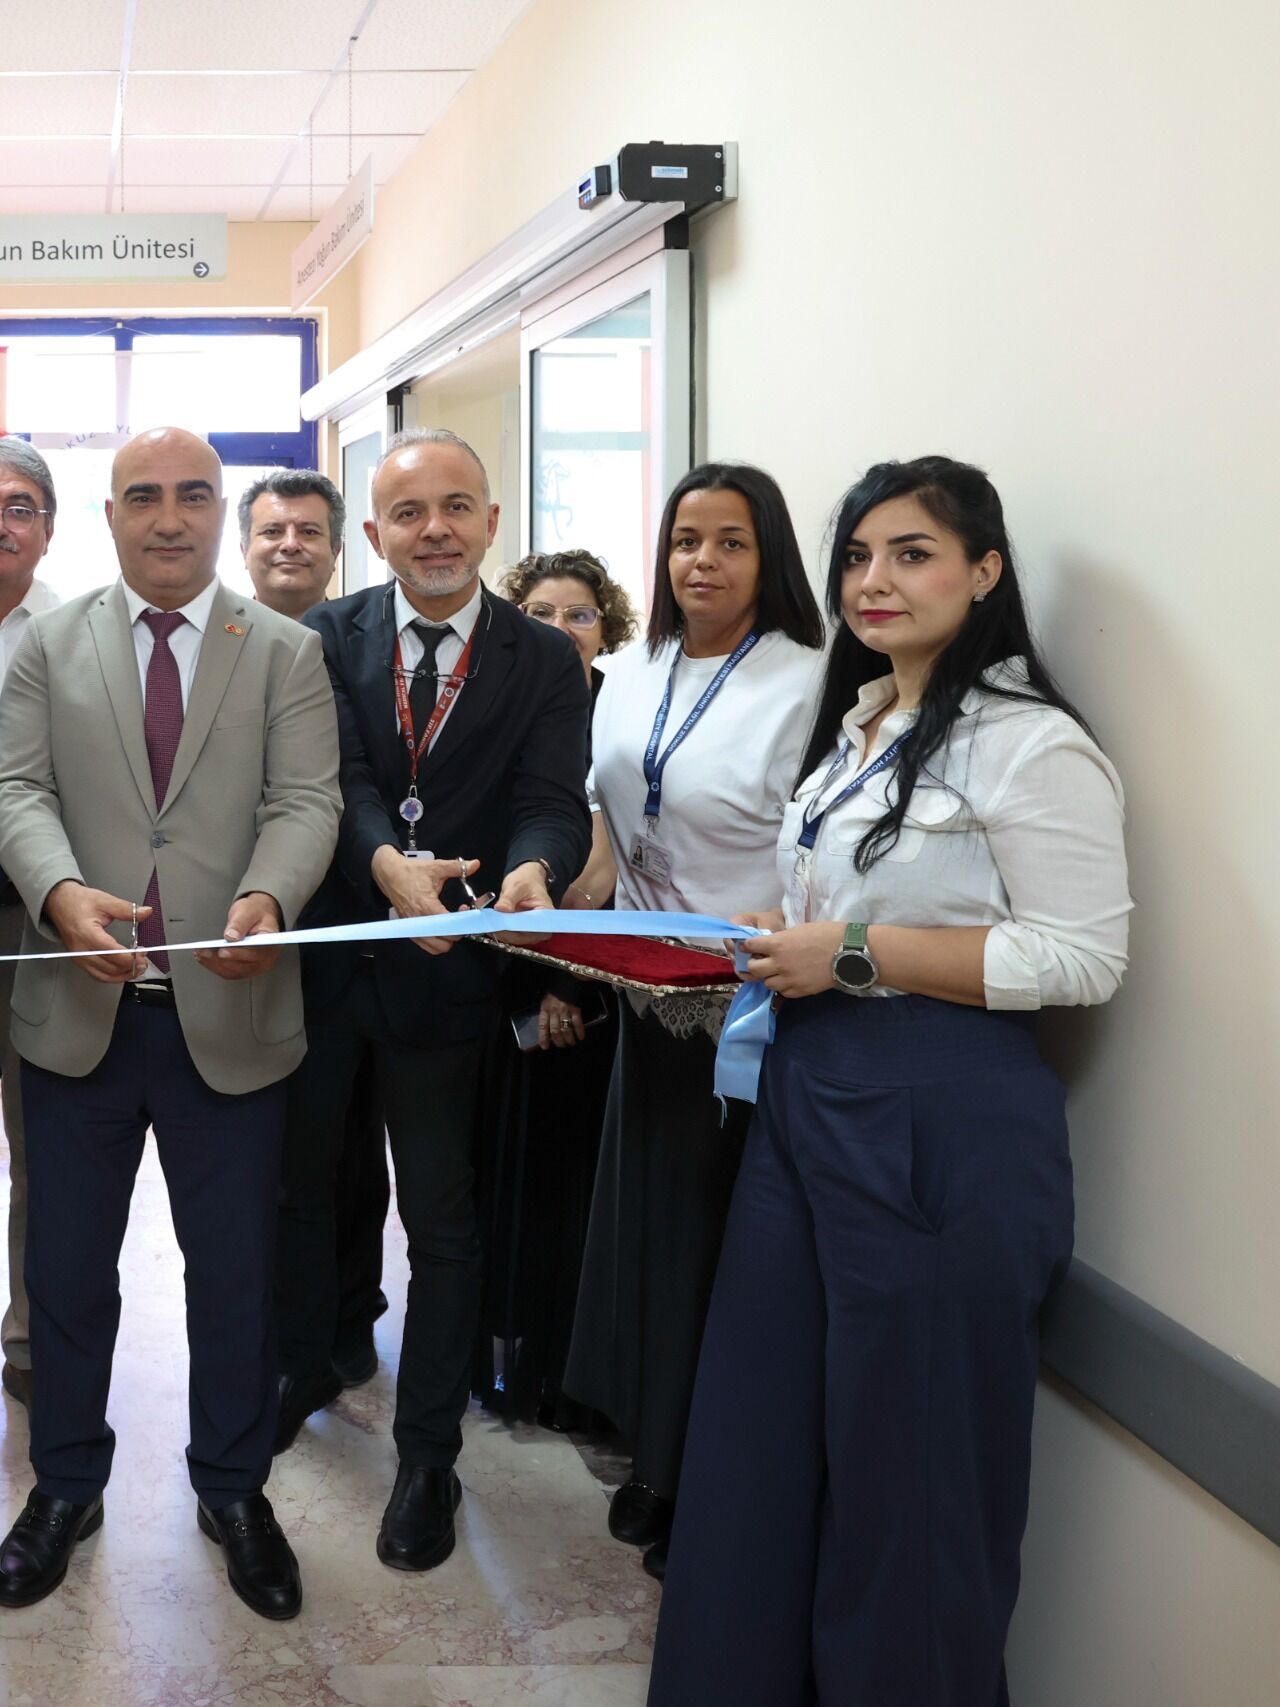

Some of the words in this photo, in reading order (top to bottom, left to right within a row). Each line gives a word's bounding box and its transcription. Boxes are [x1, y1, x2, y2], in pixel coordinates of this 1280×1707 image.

[32, 239, 103, 261] Bakım
[113, 234, 195, 260] Ünitesi
[845, 758, 884, 792] HOSPITAL
